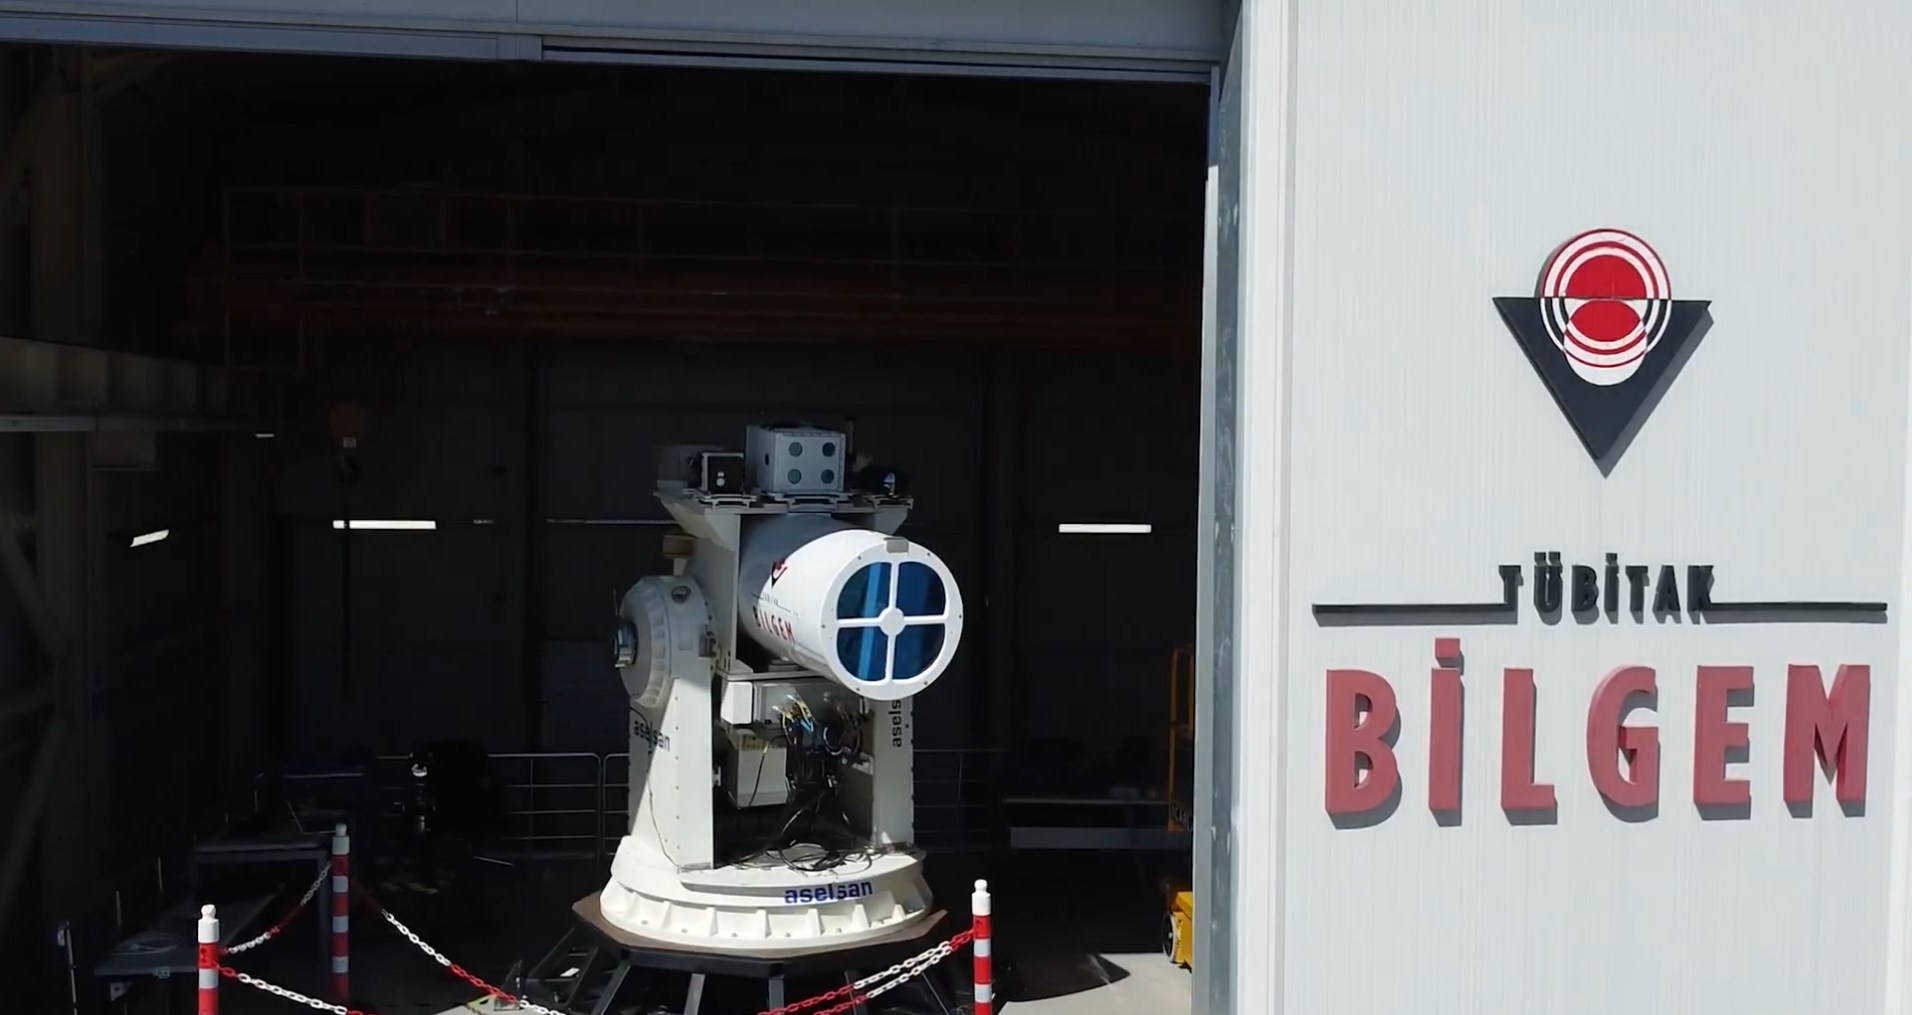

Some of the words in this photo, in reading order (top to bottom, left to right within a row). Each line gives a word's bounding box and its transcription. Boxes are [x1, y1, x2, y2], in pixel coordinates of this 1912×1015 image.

[1499, 552, 1714, 613] TÜBİTAK
[634, 720, 671, 753] aselsan
[1324, 638, 1870, 814] BİLGEM
[784, 881, 873, 904] aselsan
